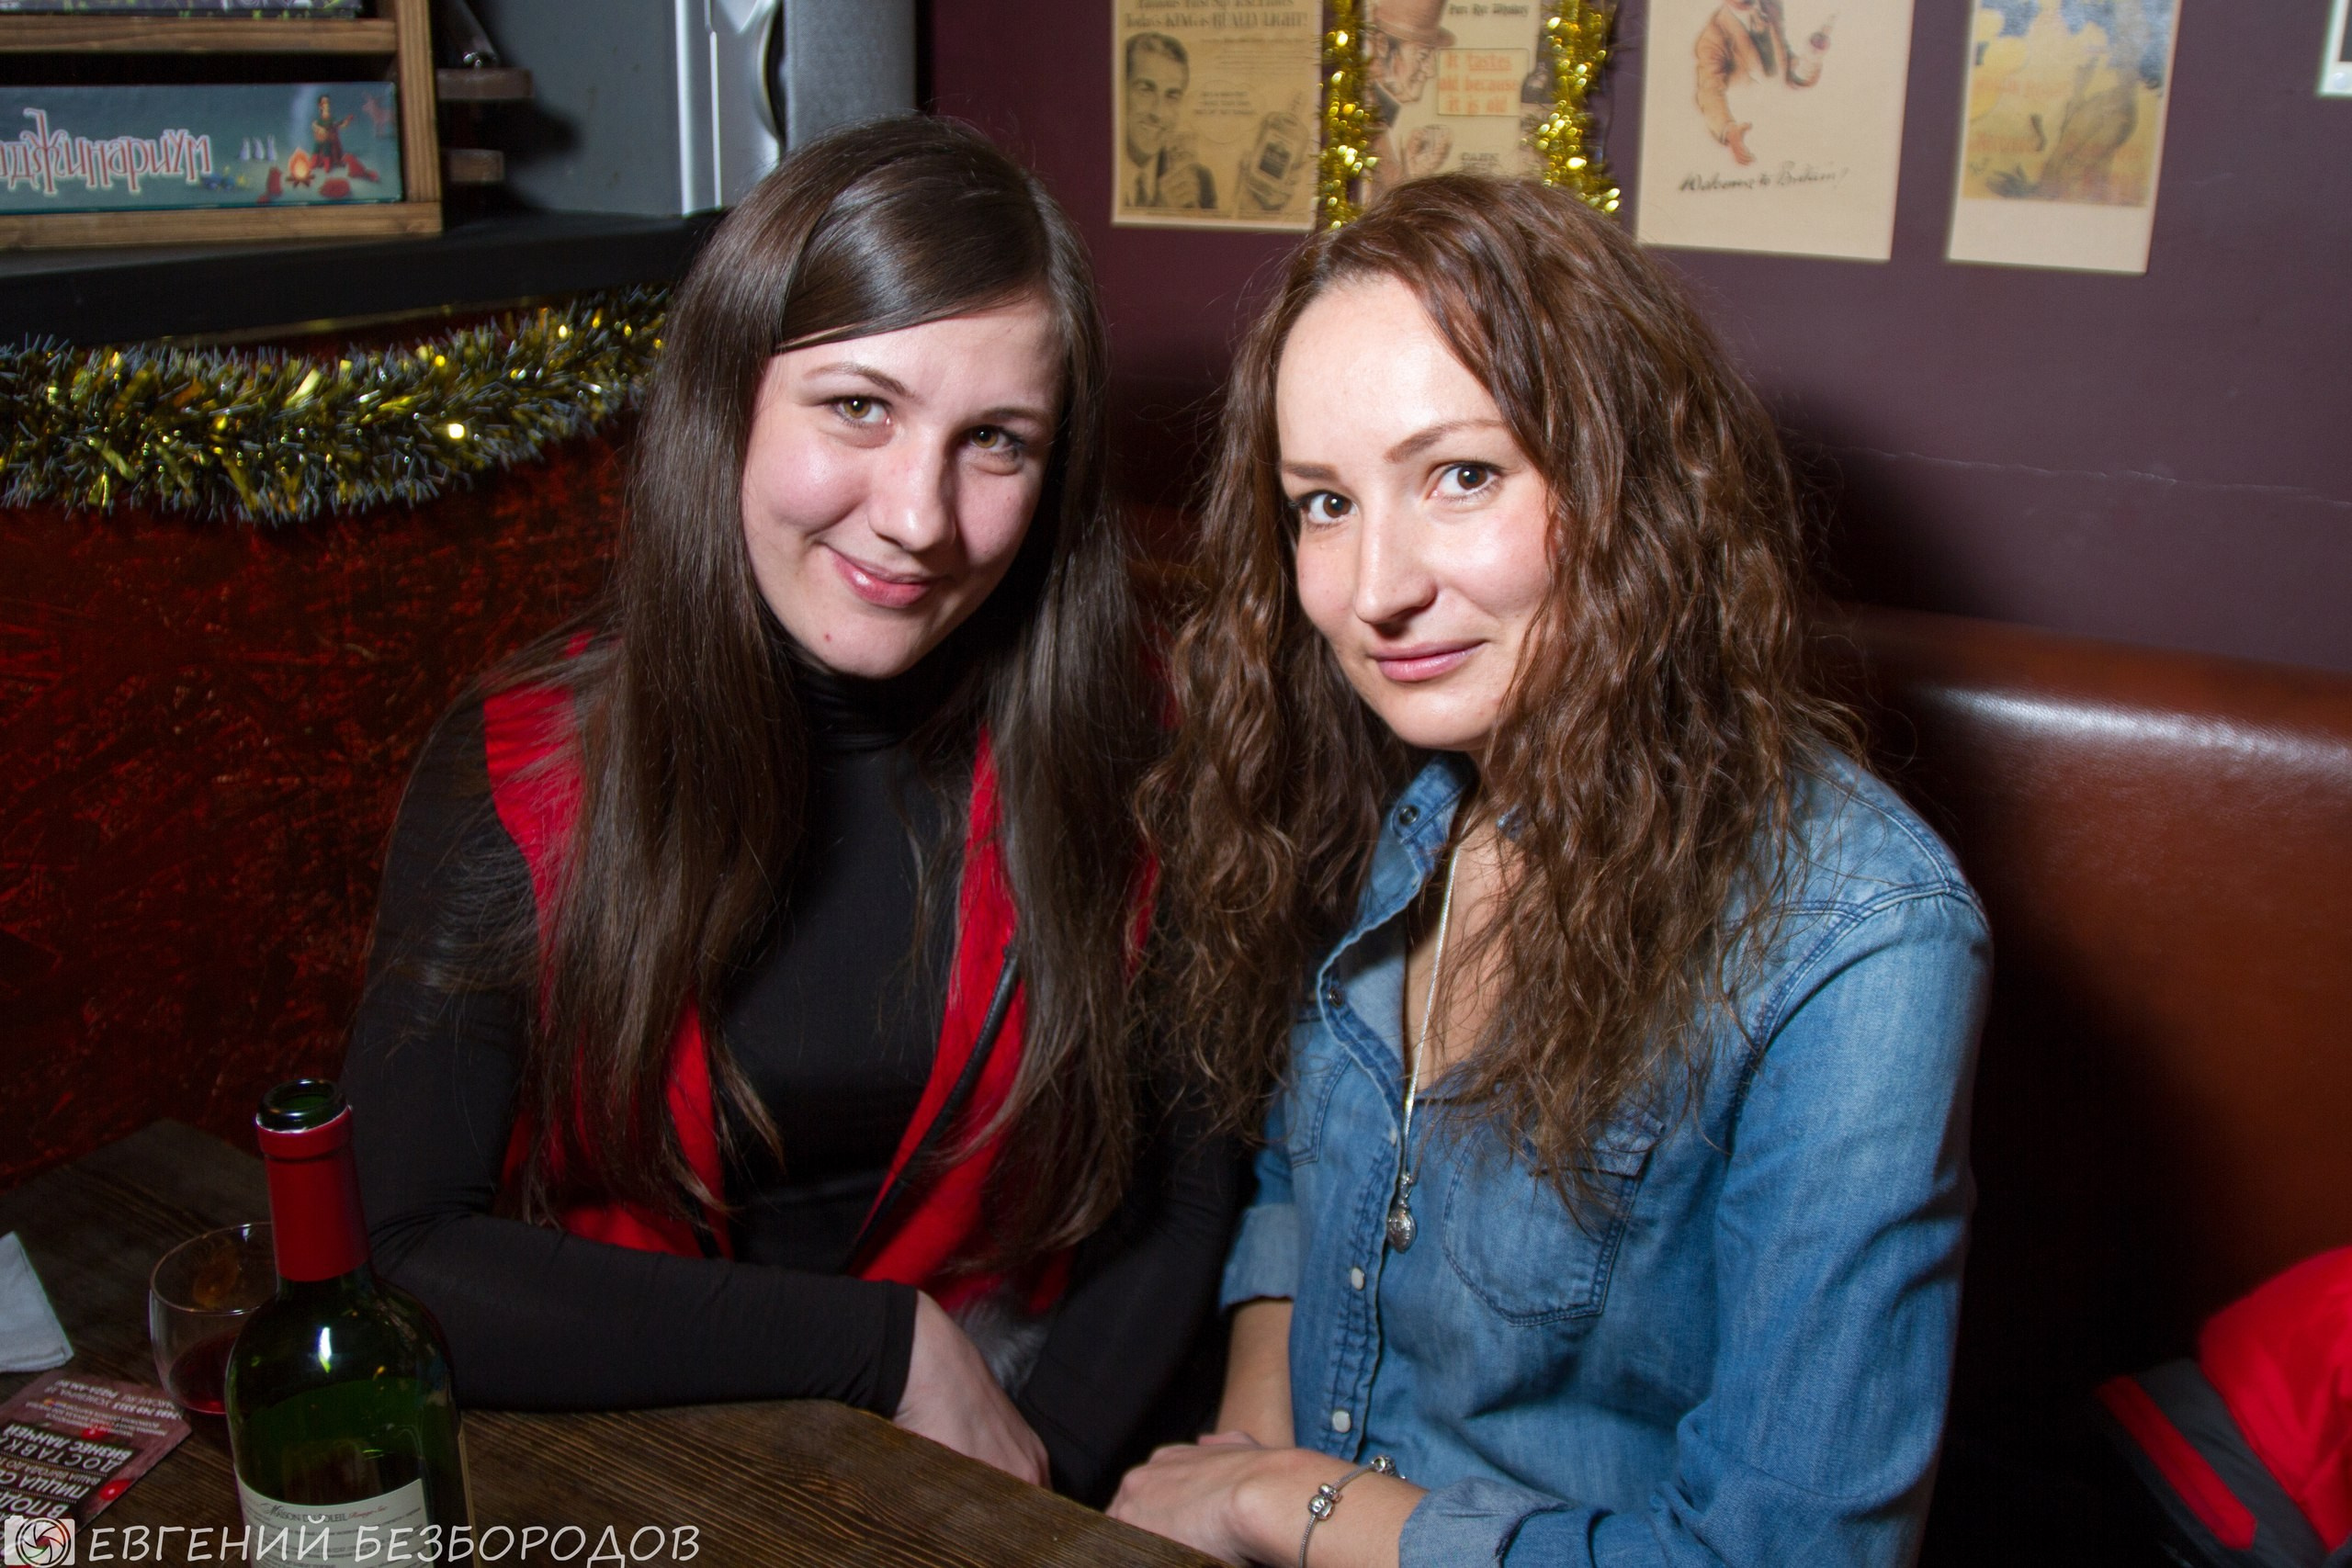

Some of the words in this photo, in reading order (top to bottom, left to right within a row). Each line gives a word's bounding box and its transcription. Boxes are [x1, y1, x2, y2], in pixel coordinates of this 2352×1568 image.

[1466, 53, 1512, 71] tastes
[1465, 75, 1518, 91] because
[2, 1423, 72, 1448] ЛАНЧЕЙ
[68, 1440, 134, 1461] БИЗНЕС
[16, 1472, 91, 1498] ПИЦЦА
[0, 1491, 53, 1516] ПОД
[44, 1502, 71, 1517] В
